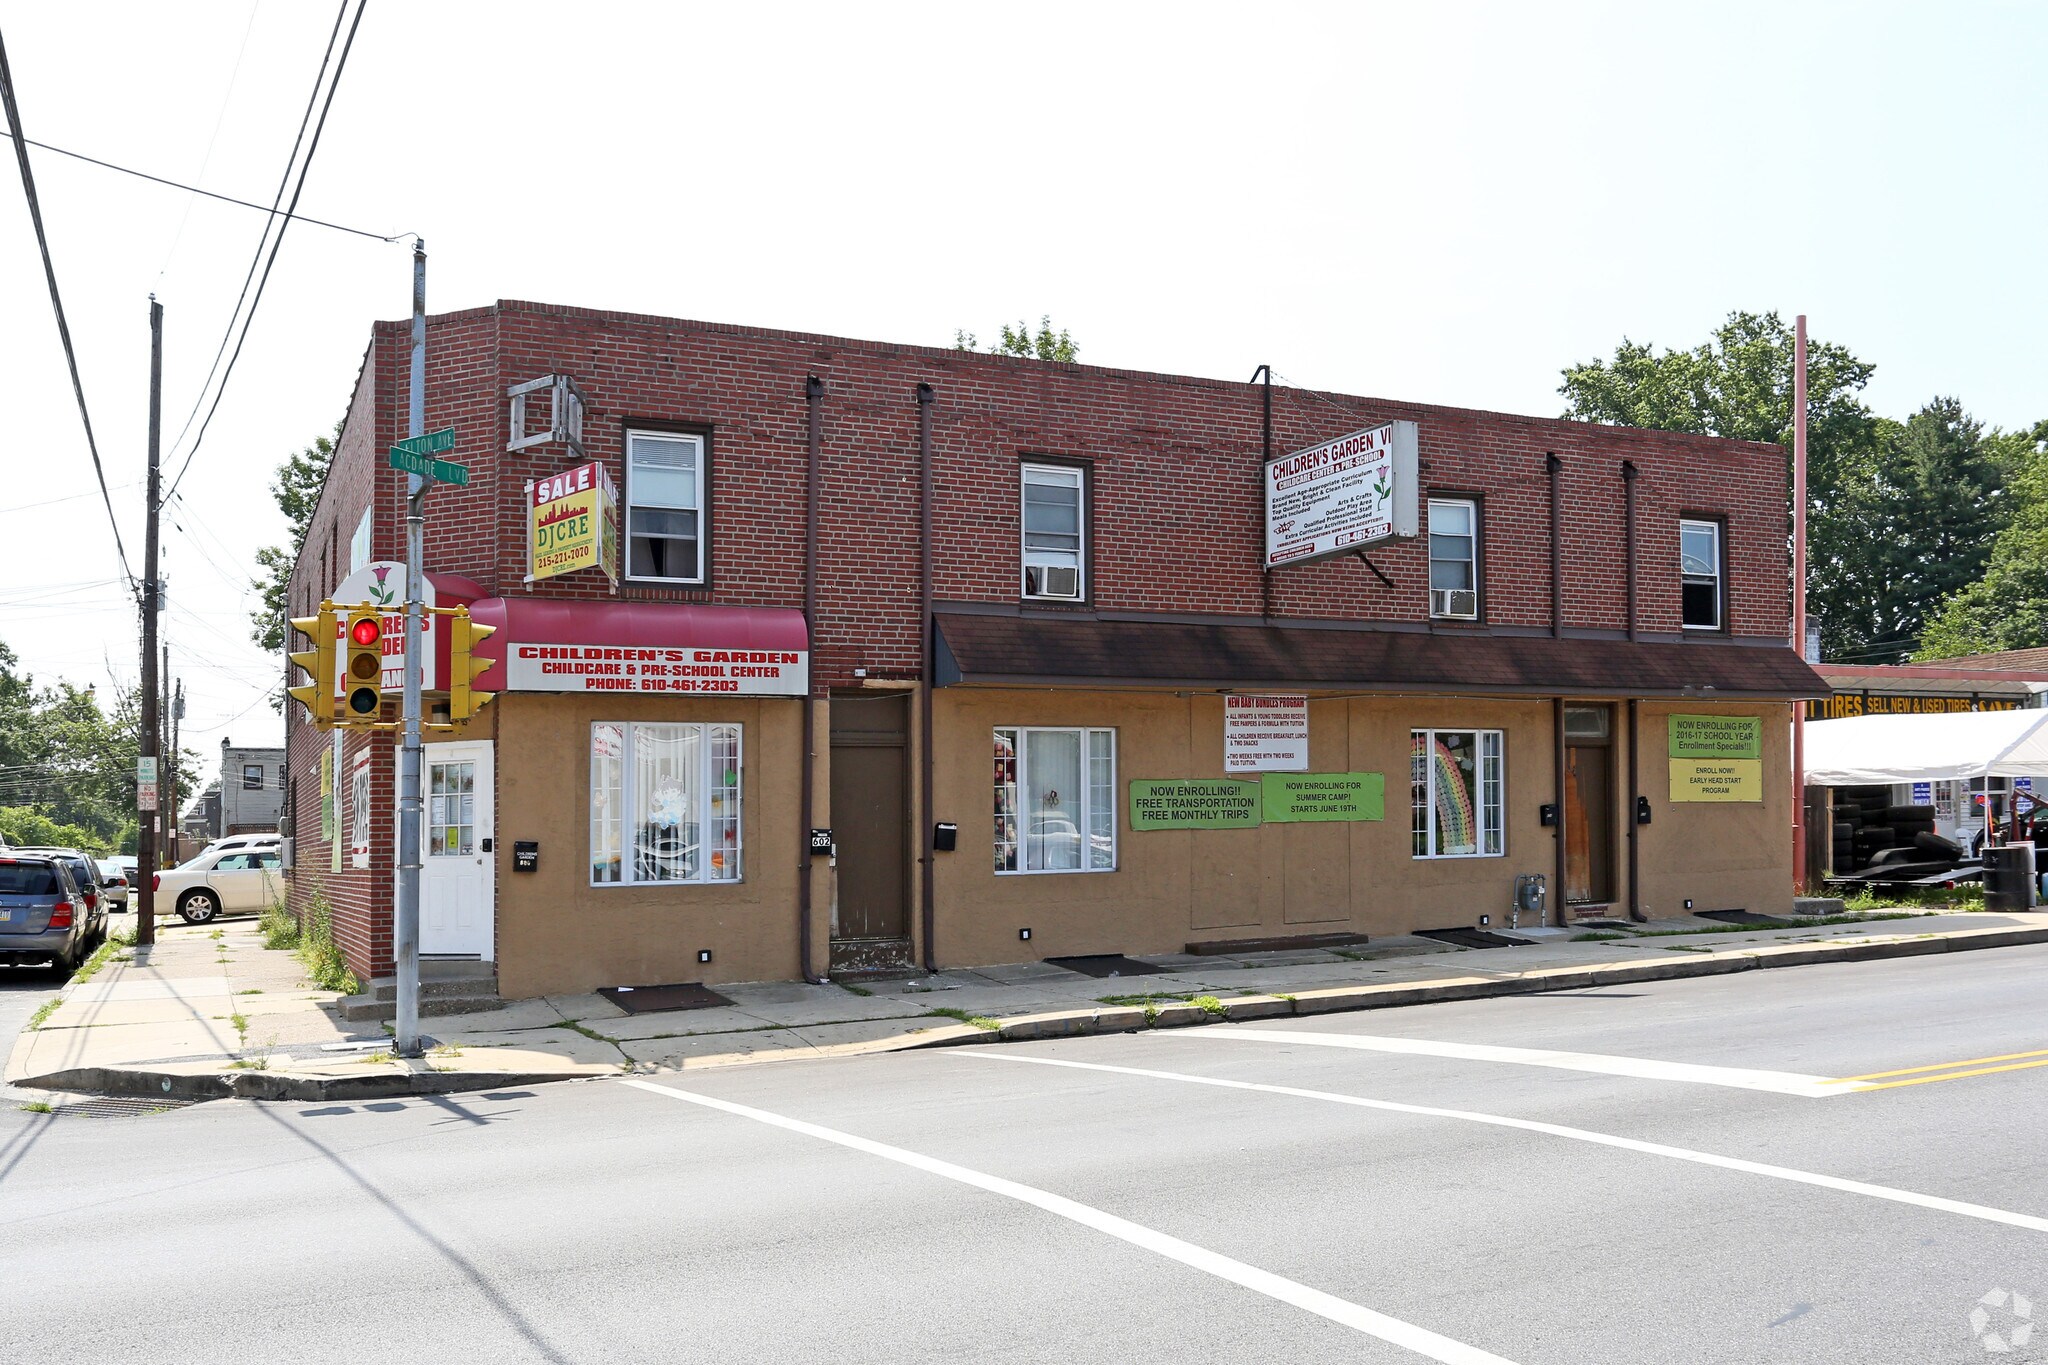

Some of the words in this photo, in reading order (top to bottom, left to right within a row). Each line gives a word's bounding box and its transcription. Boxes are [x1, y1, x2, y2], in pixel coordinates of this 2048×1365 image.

[1273, 448, 1328, 480] CHILDREN'S
[1331, 433, 1373, 461] GARDEN
[1380, 427, 1391, 445] VI
[1311, 464, 1334, 481] CENTER
[1341, 449, 1382, 471] PRE-SCHOOL
[538, 468, 590, 504] SALE
[1272, 492, 1296, 503] Excellent
[1297, 479, 1340, 496] Age-Appropriate
[1341, 469, 1373, 482] Curriculum
[1272, 500, 1288, 510] Brand
[1302, 491, 1319, 501] Bright
[1326, 484, 1342, 494] Clean
[1342, 479, 1364, 489] Facility
[1356, 492, 1372, 500] Crafts
[1282, 504, 1301, 512] Quality
[1302, 494, 1331, 507] Equipment
[1325, 506, 1346, 516] Outdoor
[1288, 506, 1311, 517] Included
[1303, 518, 1326, 529] Qualified
[1326, 509, 1359, 522] Professional
[1360, 504, 1372, 512] Staff
[538, 515, 589, 549] DJCRE
[1299, 525, 1323, 536] Curricular
[1324, 519, 1348, 529] Activities
[1349, 512, 1373, 522] Included
[1337, 524, 1389, 546] 610-461-2303
[518, 647, 683, 662] CHILDREN'S
[693, 651, 799, 664] GARDEN
[542, 662, 621, 675] CHILDCARE
[626, 664, 637, 675] &
[641, 664, 726, 677] PRE-SCHOOL
[731, 666, 780, 678] CENTER
[585, 678, 637, 690] PHONE:
[641, 679, 739, 692] 610-461-2303
[1228, 697, 1240, 708] NEW
[1241, 697, 1255, 708] BABY
[1280, 697, 1305, 708] PROGRAM
[1823, 695, 1863, 718] TIRES
[1867, 697, 1889, 713] SELL
[1891, 697, 1912, 713] NEW
[1913, 697, 1920, 713] &
[1922, 698, 1945, 713] USED
[1946, 699, 1971, 713] TIRES
[1678, 721, 1695, 729] NOW
[1696, 722, 1736, 730] ENROLLING
[1676, 731, 1702, 740] 2016-17
[1704, 732, 1733, 740] SCHOOL
[1735, 732, 1754, 740] YEAR
[1679, 741, 1715, 750] Enrollment
[1716, 742, 1751, 752] Specials!!!
[1150, 787, 1174, 796] NOW
[1177, 786, 1241, 796] ENROLLING!!
[1136, 798, 1163, 808] FREE
[1165, 798, 1255, 808] TRANSPORTATION
[1142, 810, 1169, 820] FREE
[1171, 810, 1219, 820] MONTHLY
[1221, 810, 1249, 819] TRIPS
[813, 838, 830, 846] 602
